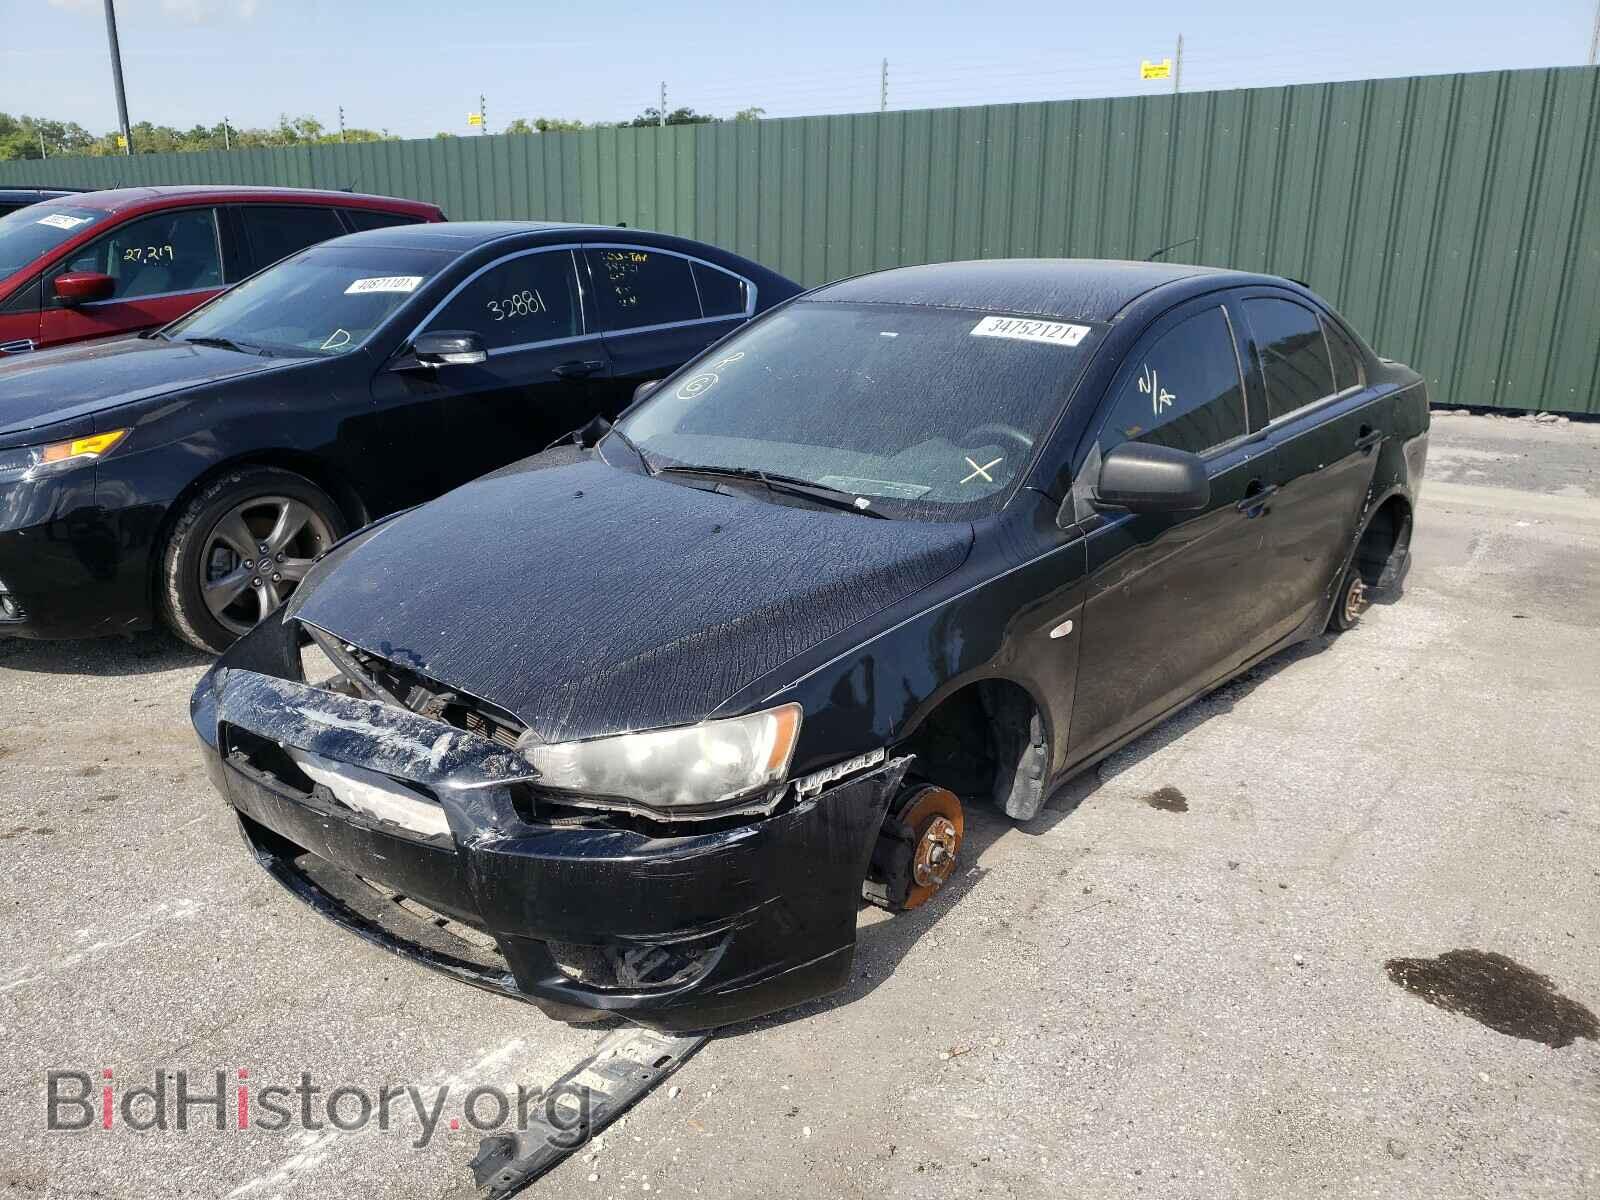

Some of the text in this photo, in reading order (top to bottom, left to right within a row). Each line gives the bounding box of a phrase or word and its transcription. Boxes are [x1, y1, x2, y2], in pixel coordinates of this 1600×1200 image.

[123, 246, 173, 264] 27,219
[487, 289, 547, 321] 32881
[1138, 363, 1176, 417] N/A
